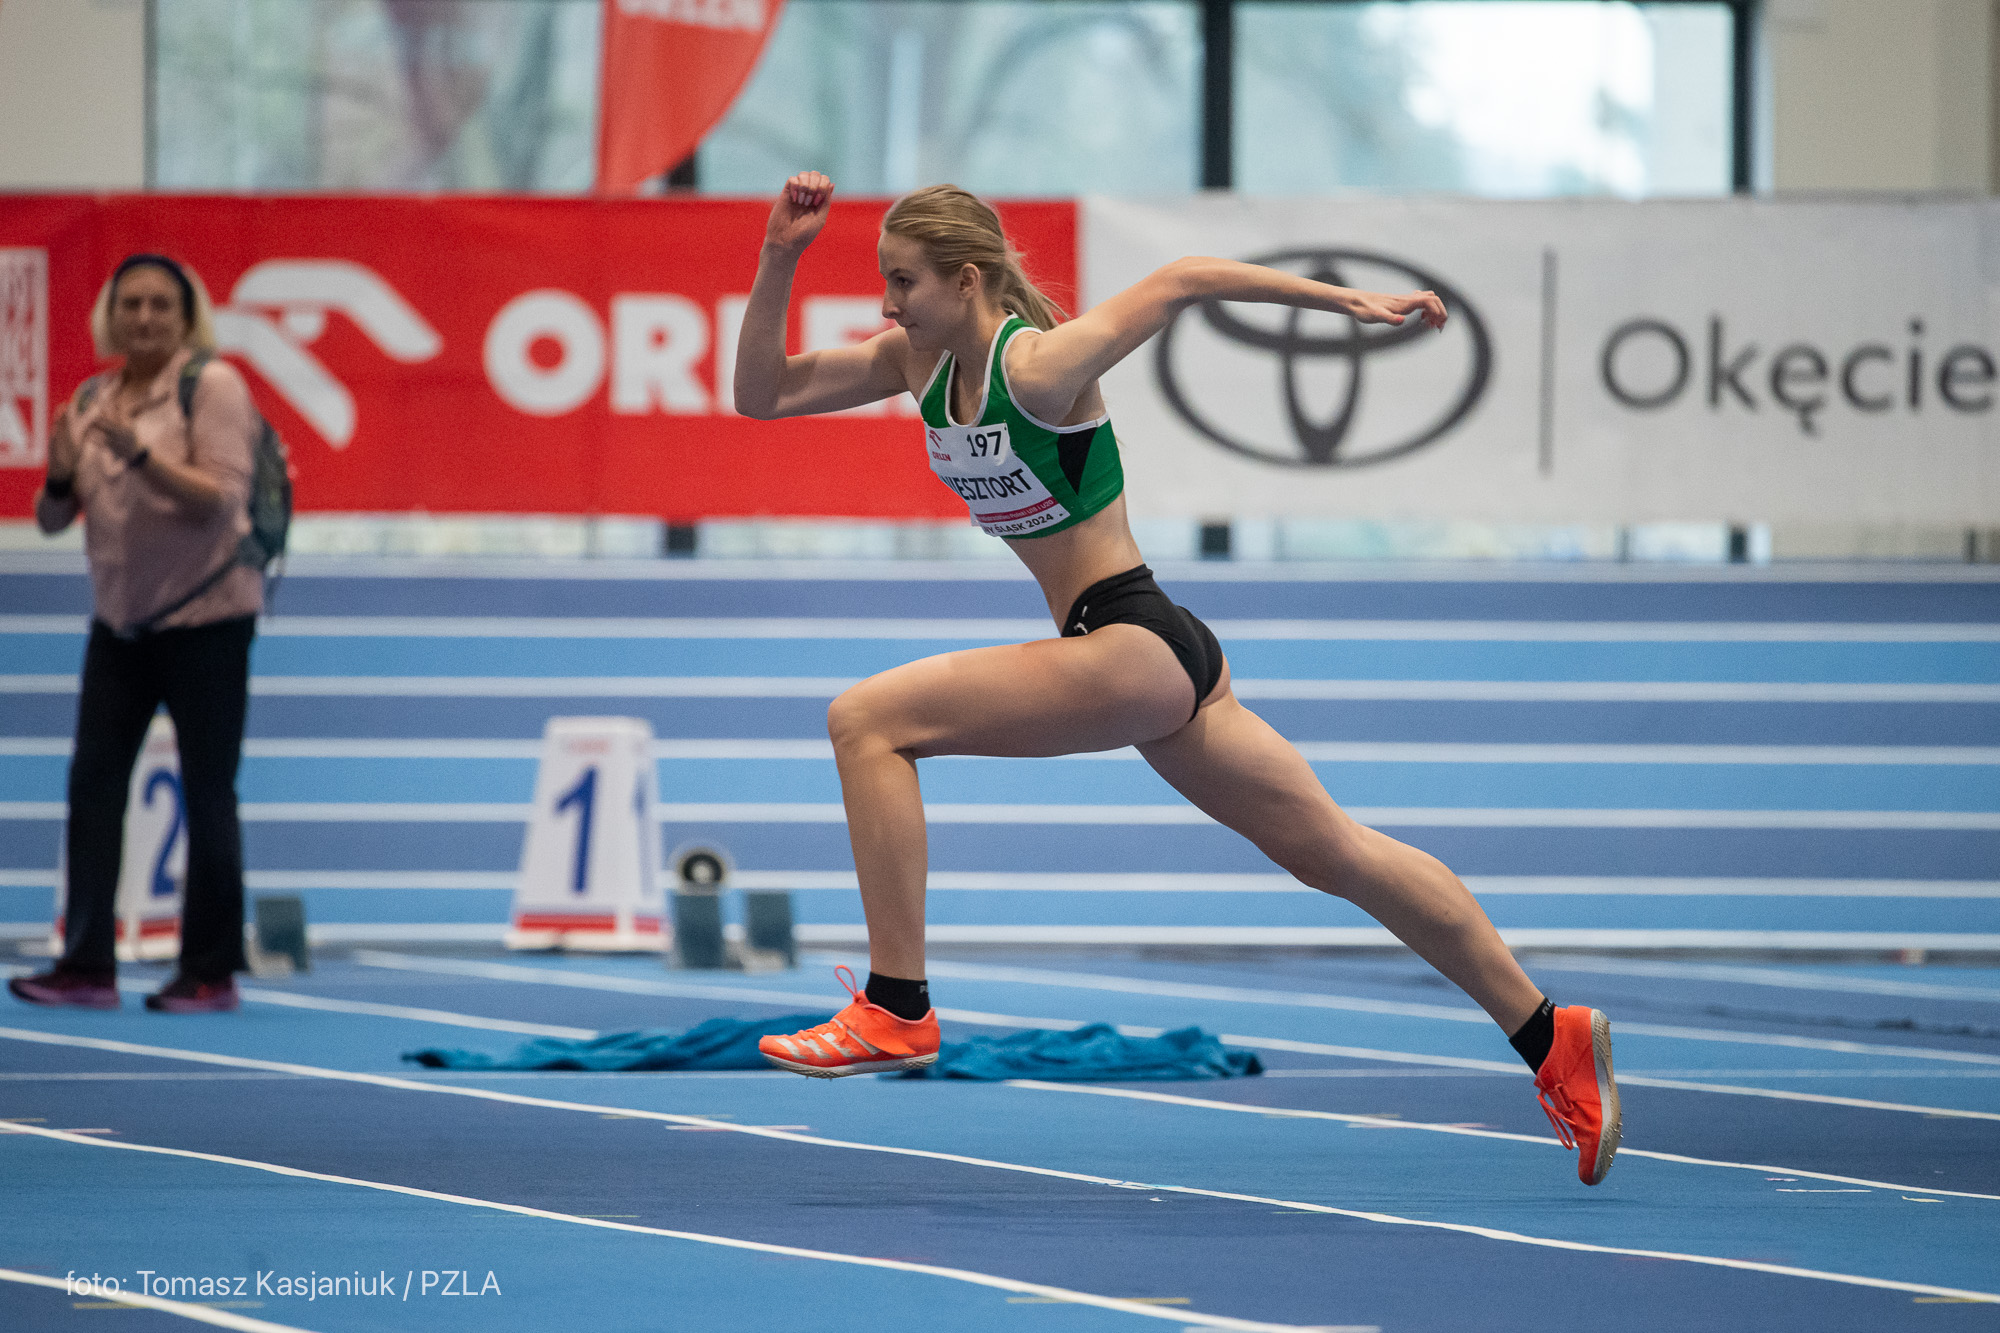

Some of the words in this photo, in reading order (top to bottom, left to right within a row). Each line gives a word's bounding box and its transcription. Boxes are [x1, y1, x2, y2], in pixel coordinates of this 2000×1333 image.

[1601, 314, 1997, 437] Okęcie
[966, 430, 1002, 457] 197
[995, 523, 1026, 533] ŚLĄSK
[1026, 513, 1054, 528] 2024
[143, 768, 186, 897] 2
[553, 765, 598, 893] 1
